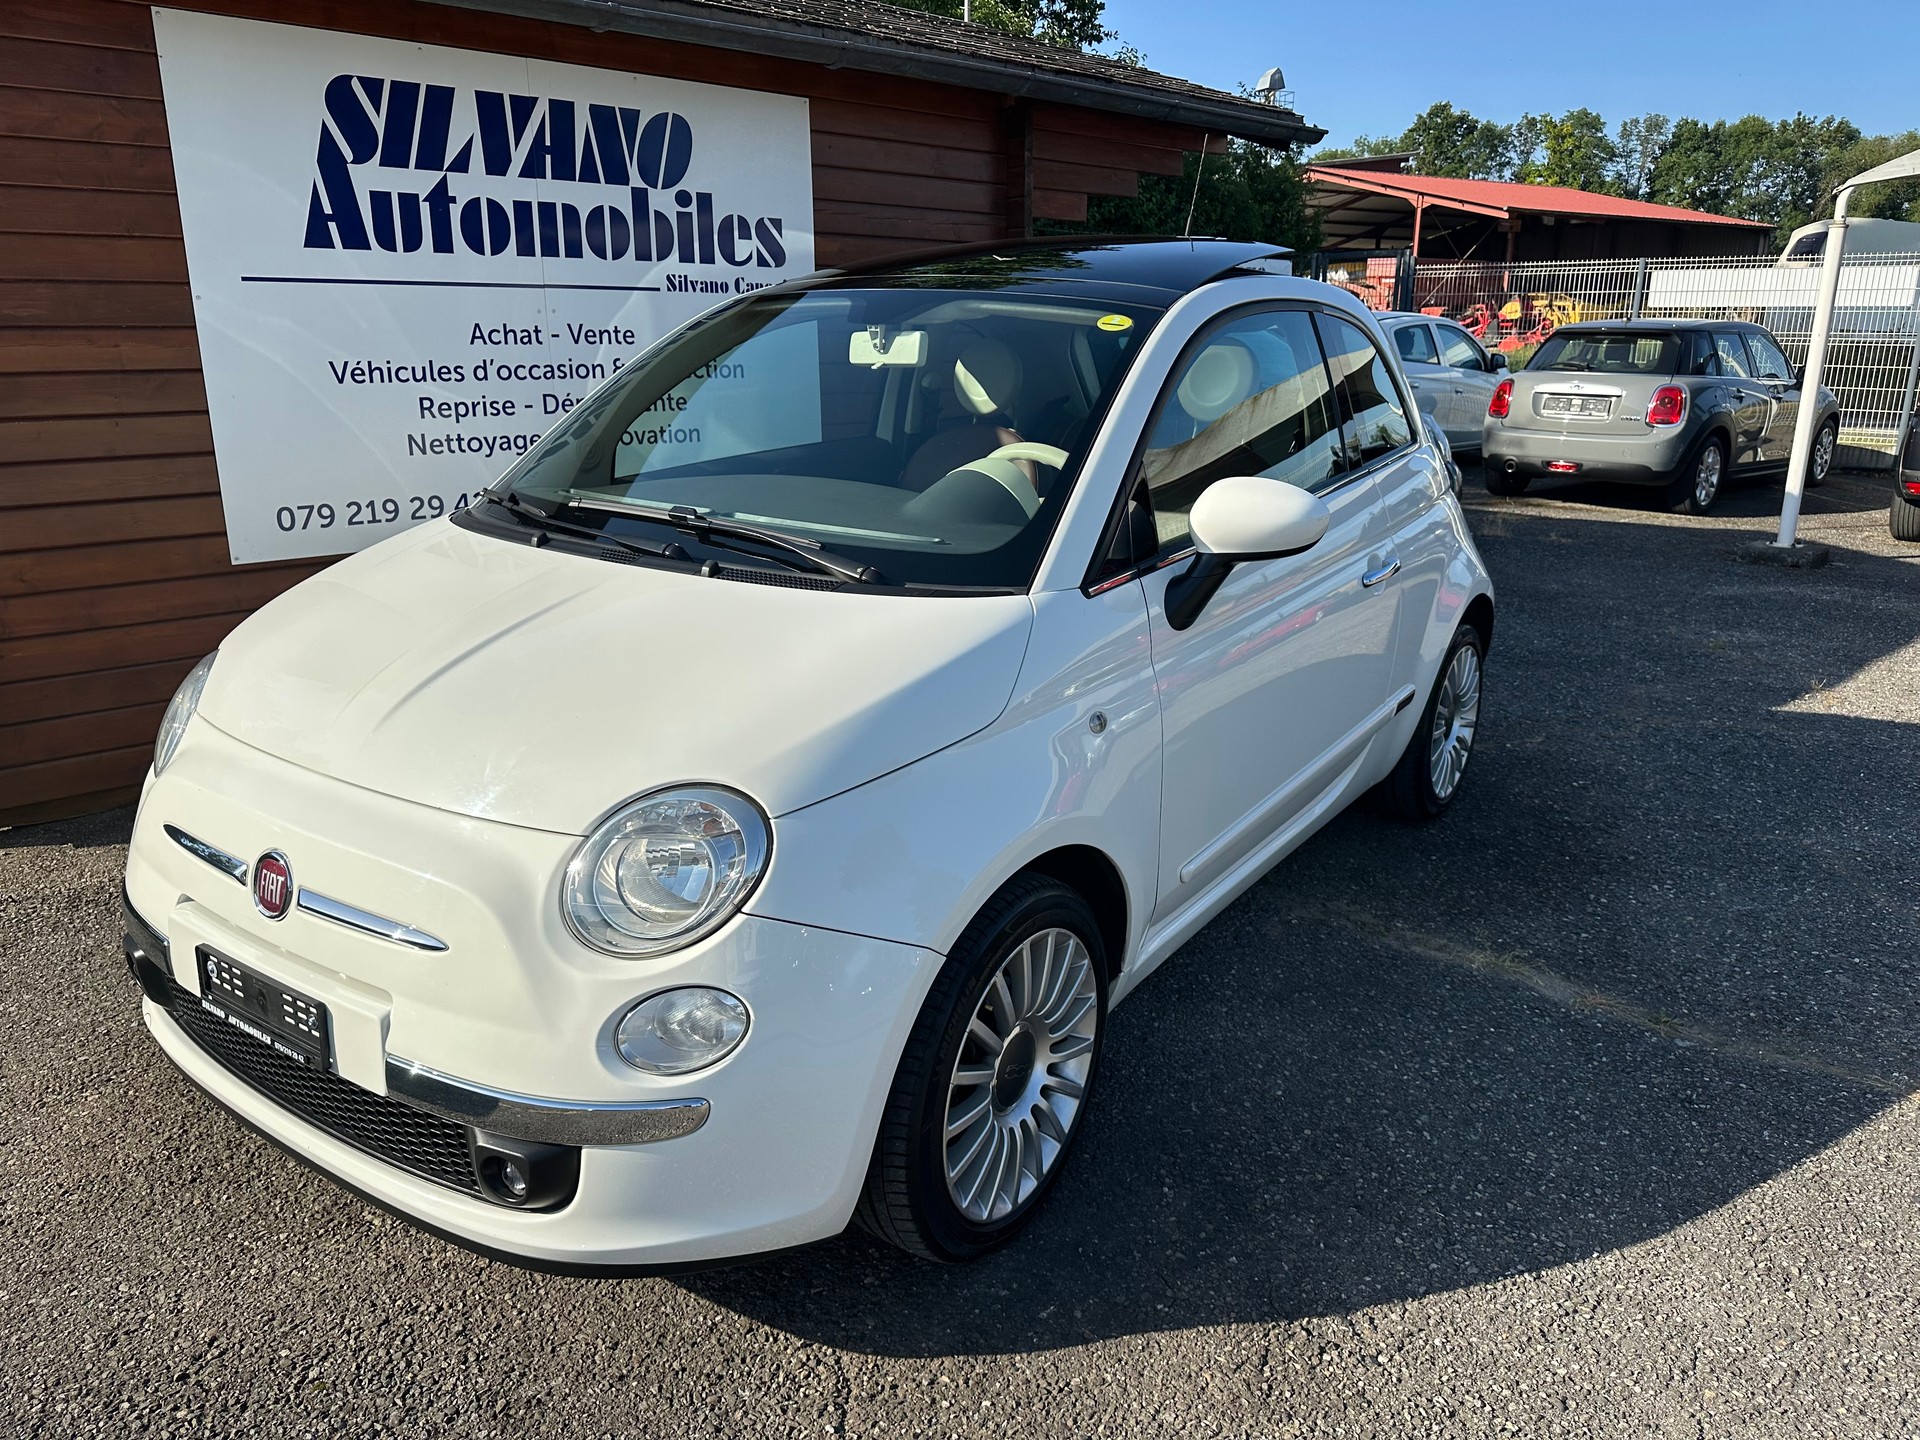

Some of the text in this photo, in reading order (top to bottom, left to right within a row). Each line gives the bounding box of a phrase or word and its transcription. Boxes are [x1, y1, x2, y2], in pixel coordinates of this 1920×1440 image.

[317, 74, 693, 190] SILVANO
[304, 162, 787, 268] Automobiles
[665, 273, 730, 294] Silvano
[469, 322, 543, 346] Achat
[567, 324, 636, 347] Vente
[328, 359, 466, 384] Véhicules
[418, 395, 516, 425] Reprise
[407, 424, 701, 457] Nettoyage ovation
[276, 491, 480, 532] 079 219 29 4
[259, 868, 286, 906] FIAT
[201, 999, 226, 1019] SILVANO
[228, 1014, 271, 1045] AUTOMOBILES
